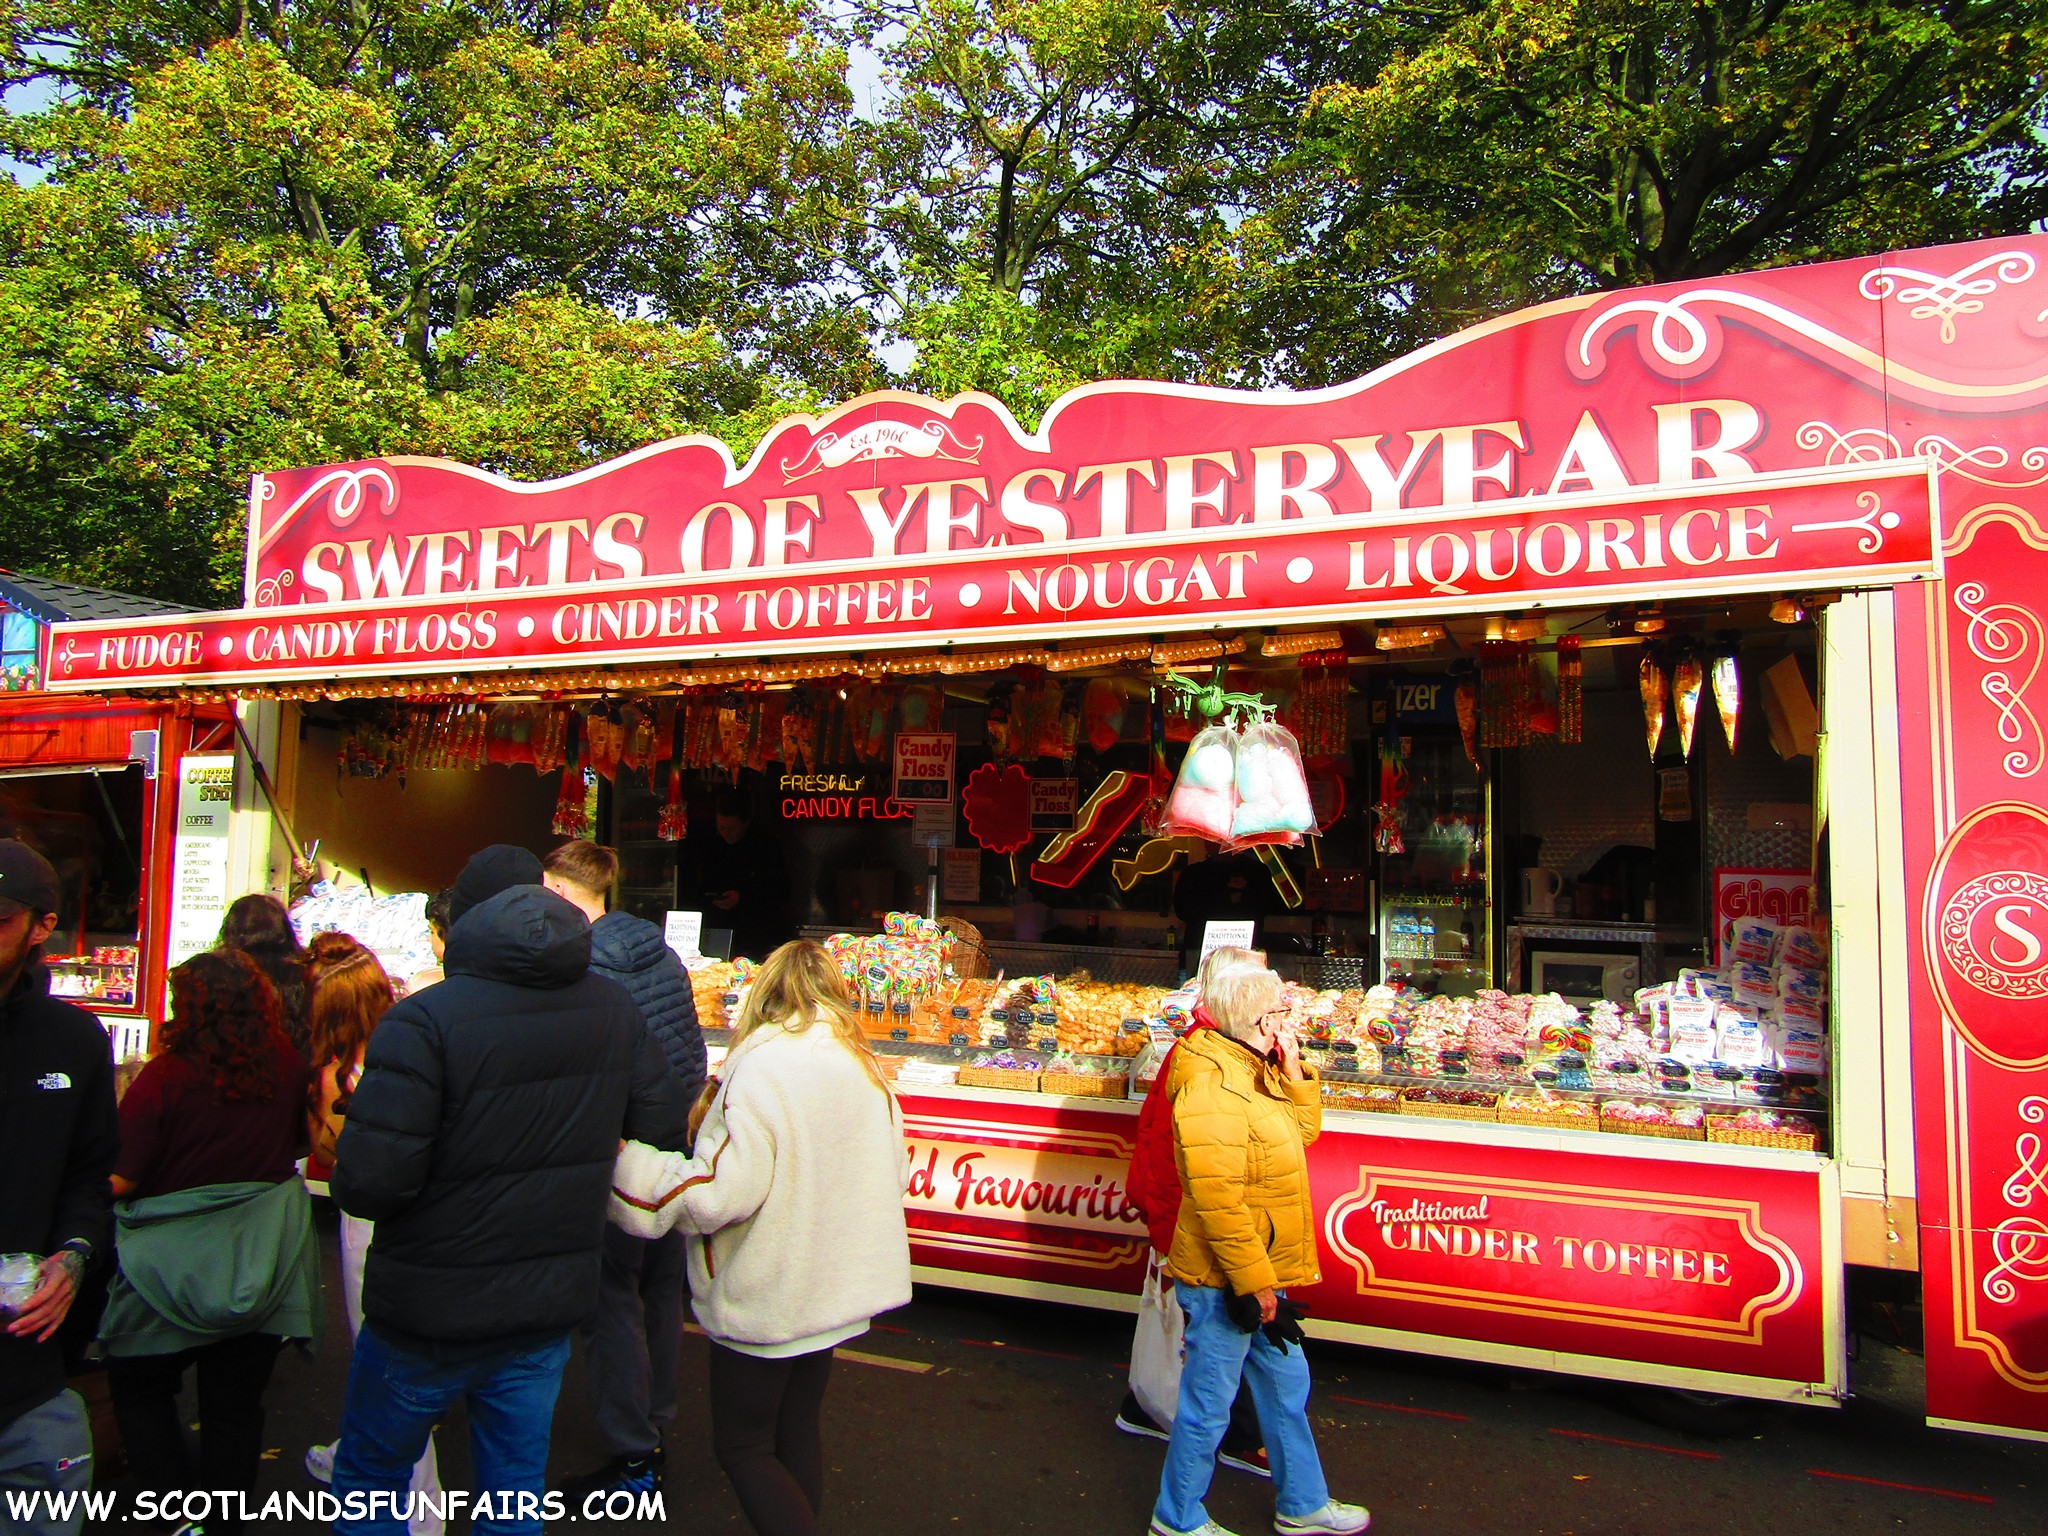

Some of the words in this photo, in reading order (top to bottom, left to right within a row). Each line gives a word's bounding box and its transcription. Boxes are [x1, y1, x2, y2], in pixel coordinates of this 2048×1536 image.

[850, 435, 872, 450] Est.
[876, 428, 909, 444] 1960
[299, 512, 648, 604] SWEETS
[680, 494, 823, 573] OF
[847, 399, 1764, 558] YESTERYEAR
[1345, 504, 1781, 596] LIQUORICE
[1002, 550, 1258, 616] NOUGAT
[551, 591, 722, 644] CINDER
[736, 576, 934, 632] TOFFEE
[97, 631, 204, 671] FUDGE
[245, 618, 366, 662] CANDY
[374, 609, 498, 653] FLOSS
[899, 737, 952, 762] Candy
[902, 758, 946, 778] Floss
[782, 796, 853, 819] CANDY
[1031, 782, 1075, 800] Candy
[1035, 798, 1071, 812] Floss
[185, 815, 213, 825] COFFEE
[1207, 932, 1249, 940] TRADITIONAL
[1989, 904, 2041, 967] S
[905, 1145, 939, 1200] ld
[1369, 1195, 1489, 1226] Traditional
[1381, 1222, 1542, 1266] CINDER
[1552, 1235, 1733, 1288] TOFFEE
